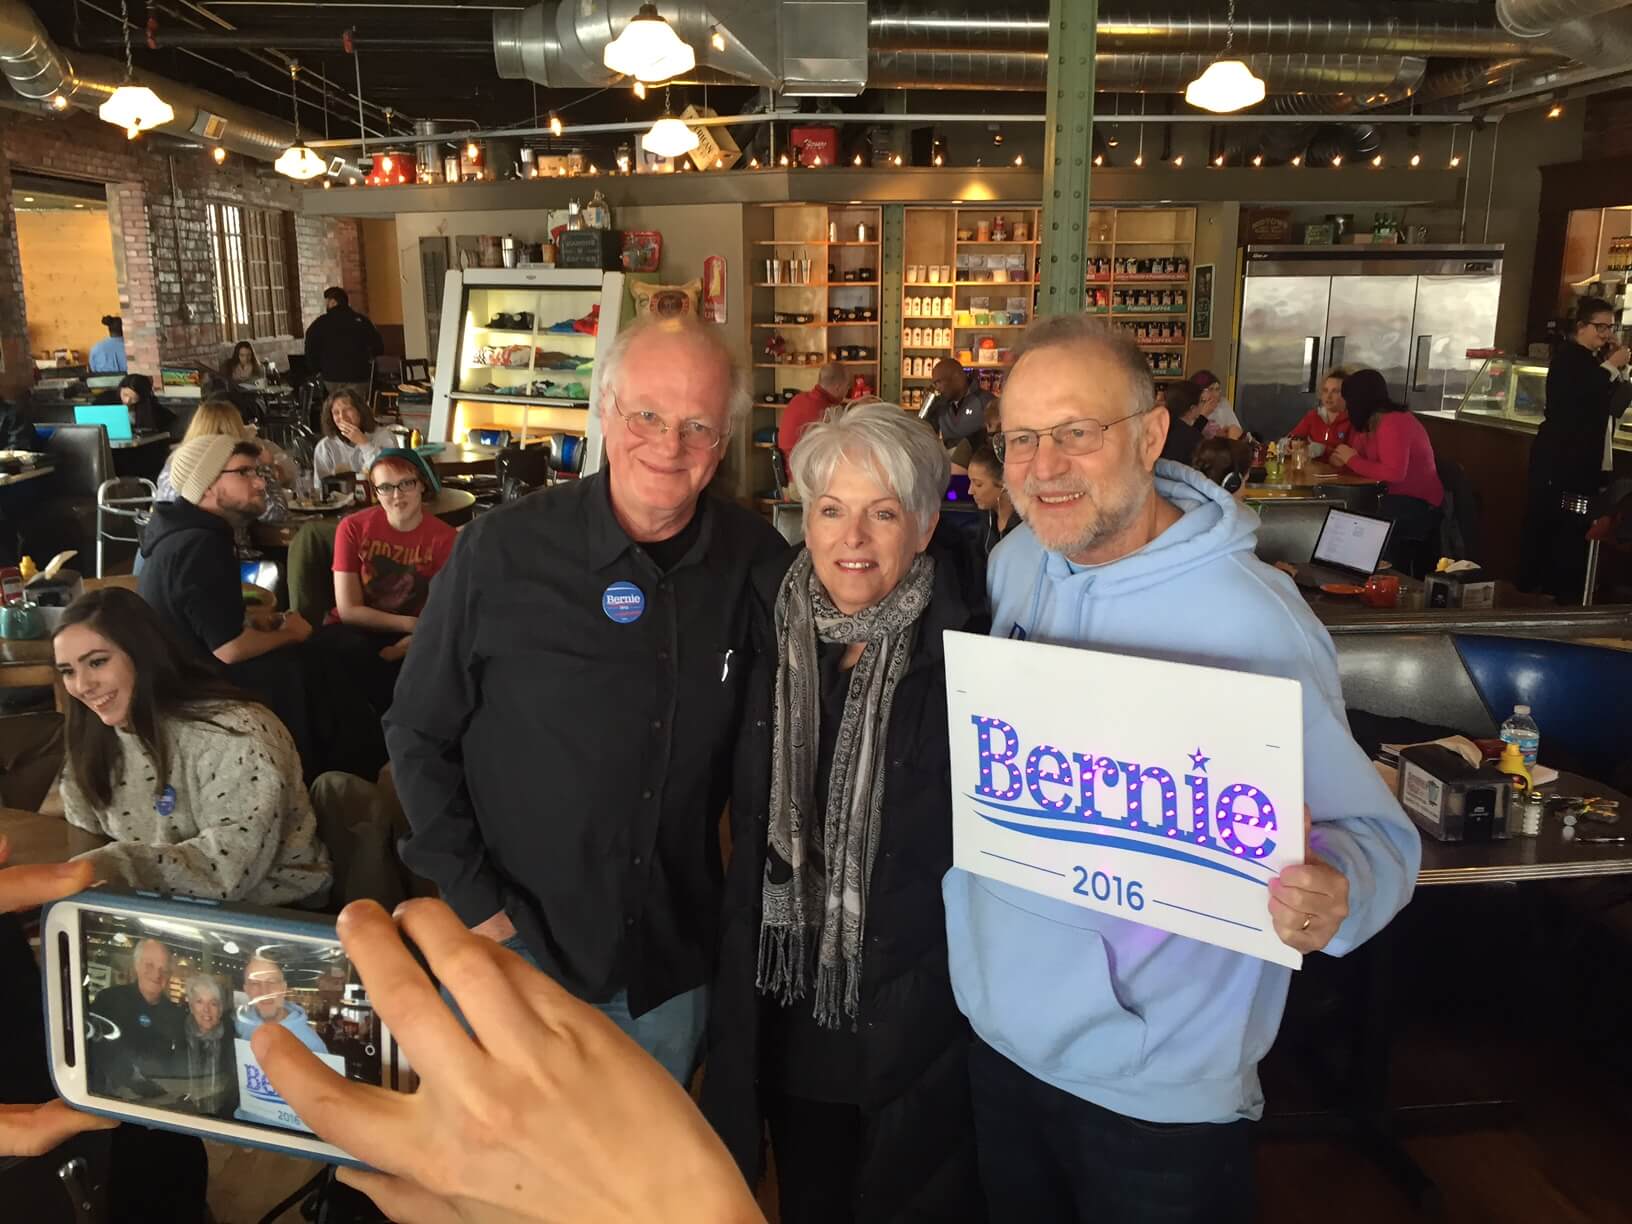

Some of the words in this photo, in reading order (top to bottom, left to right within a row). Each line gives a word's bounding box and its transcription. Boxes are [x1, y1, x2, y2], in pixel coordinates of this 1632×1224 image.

[607, 594, 641, 605] Bernie
[971, 715, 1277, 859] Bernie
[1072, 866, 1144, 911] 2016
